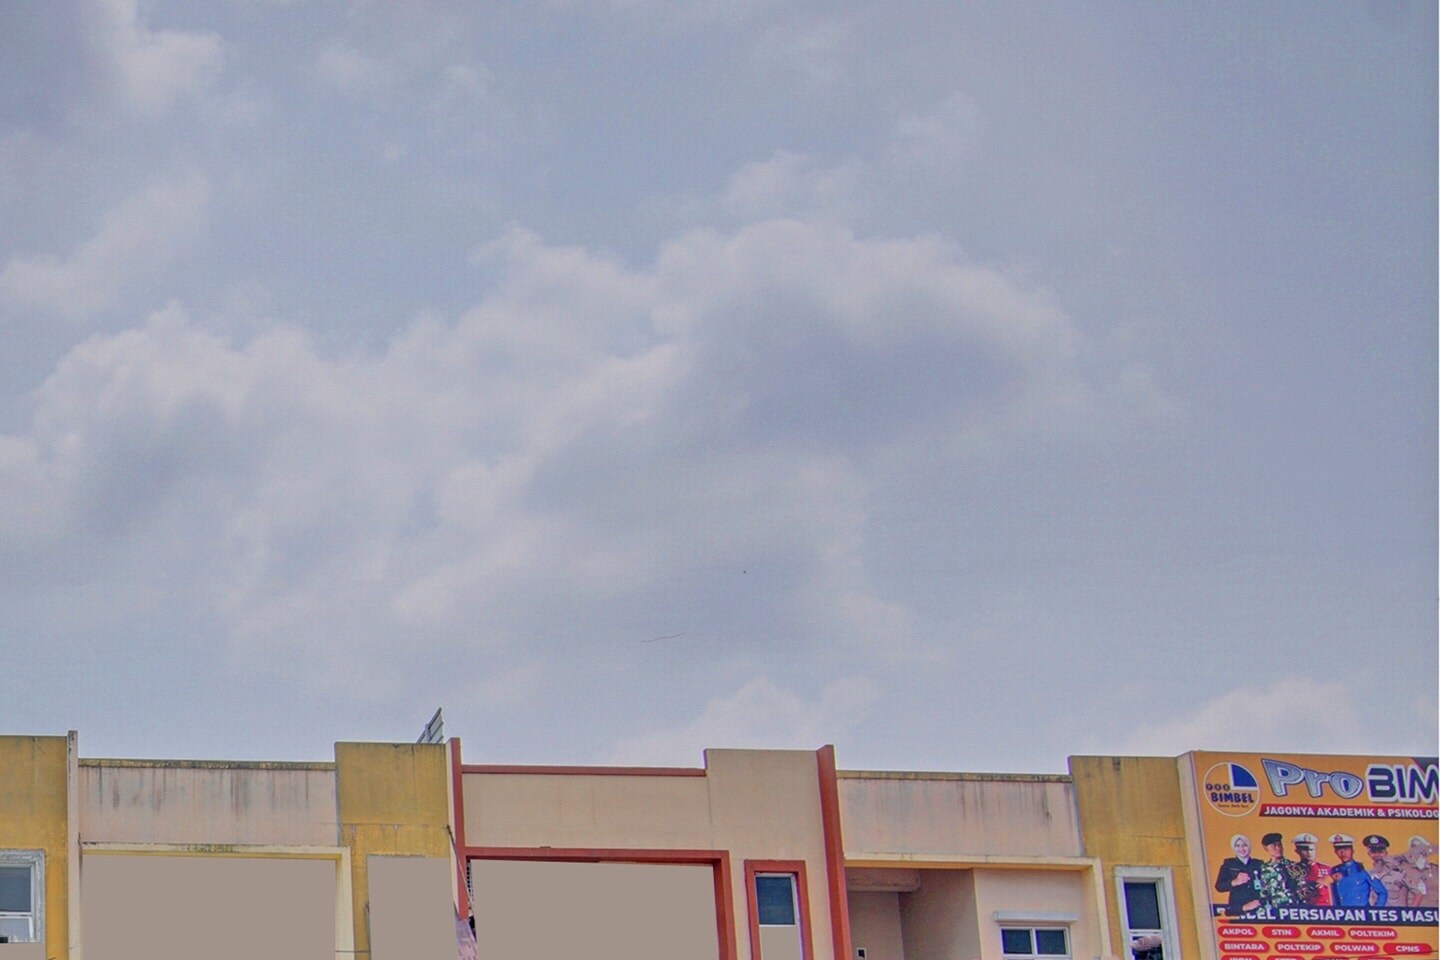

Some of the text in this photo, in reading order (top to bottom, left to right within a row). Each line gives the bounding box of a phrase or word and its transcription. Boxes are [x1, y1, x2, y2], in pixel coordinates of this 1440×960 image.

[1211, 792, 1254, 803] BIMBEL
[1264, 806, 1315, 817] JAGONYA
[1317, 807, 1375, 817] AKADEMIK
[1377, 808, 1387, 817] &
[1280, 908, 1365, 921] PERSIAPAN
[1369, 909, 1398, 922] TES
[1222, 928, 1254, 936] AKPOL
[1350, 930, 1395, 938] POLTEKIM
[1224, 943, 1264, 951] BINTARA
